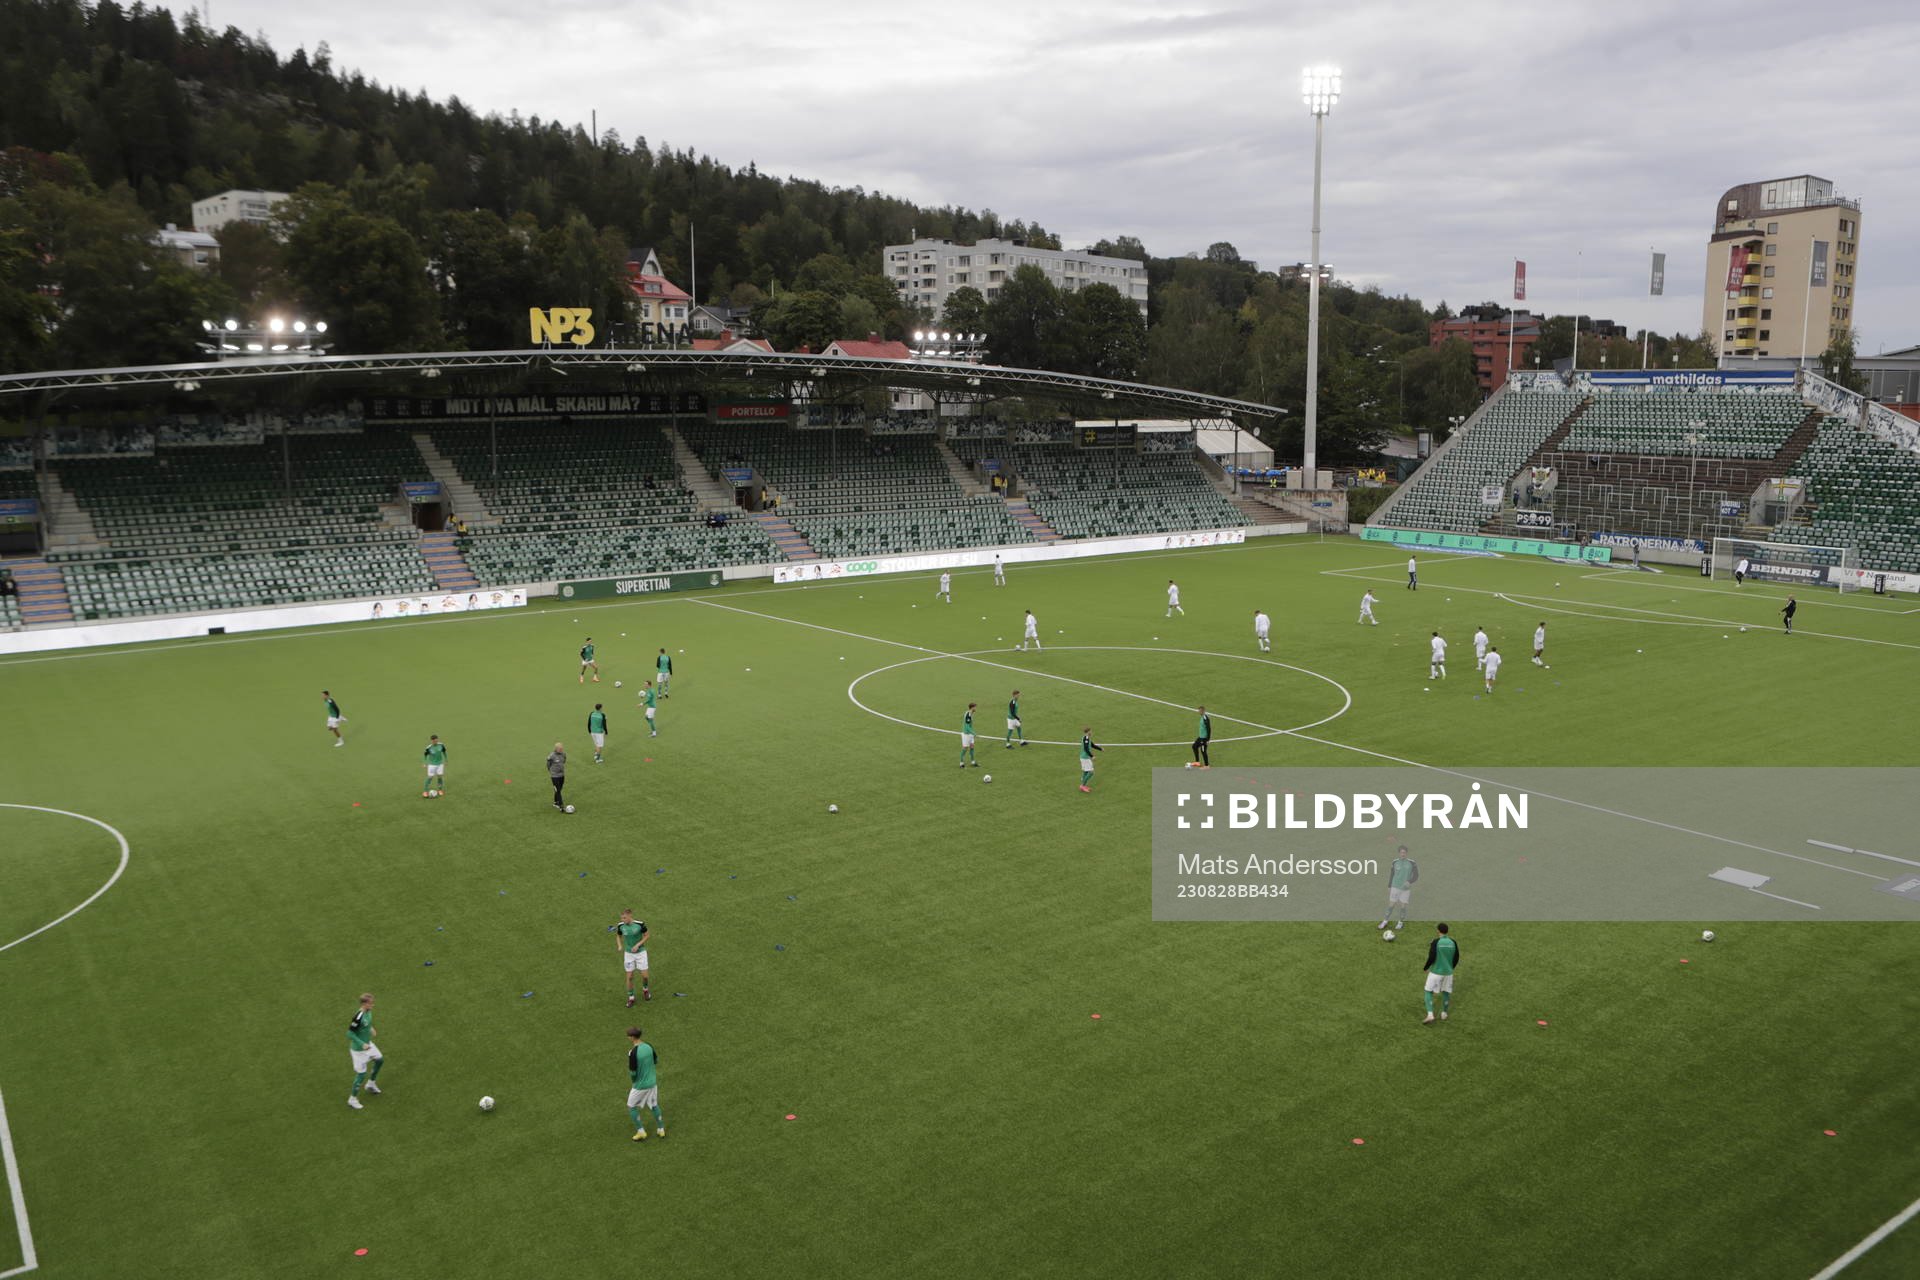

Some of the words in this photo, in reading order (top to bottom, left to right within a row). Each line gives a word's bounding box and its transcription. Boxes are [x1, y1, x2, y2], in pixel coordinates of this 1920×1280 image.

[529, 307, 595, 345] NP3
[1653, 374, 1722, 385] mathildas
[446, 399, 481, 414] MOT
[731, 407, 776, 416] PORTELLO
[1600, 534, 1679, 551] PATRONERNA
[846, 561, 878, 573] coop
[1750, 564, 1821, 578] BERNERS
[616, 577, 671, 594] SUPERETTAN
